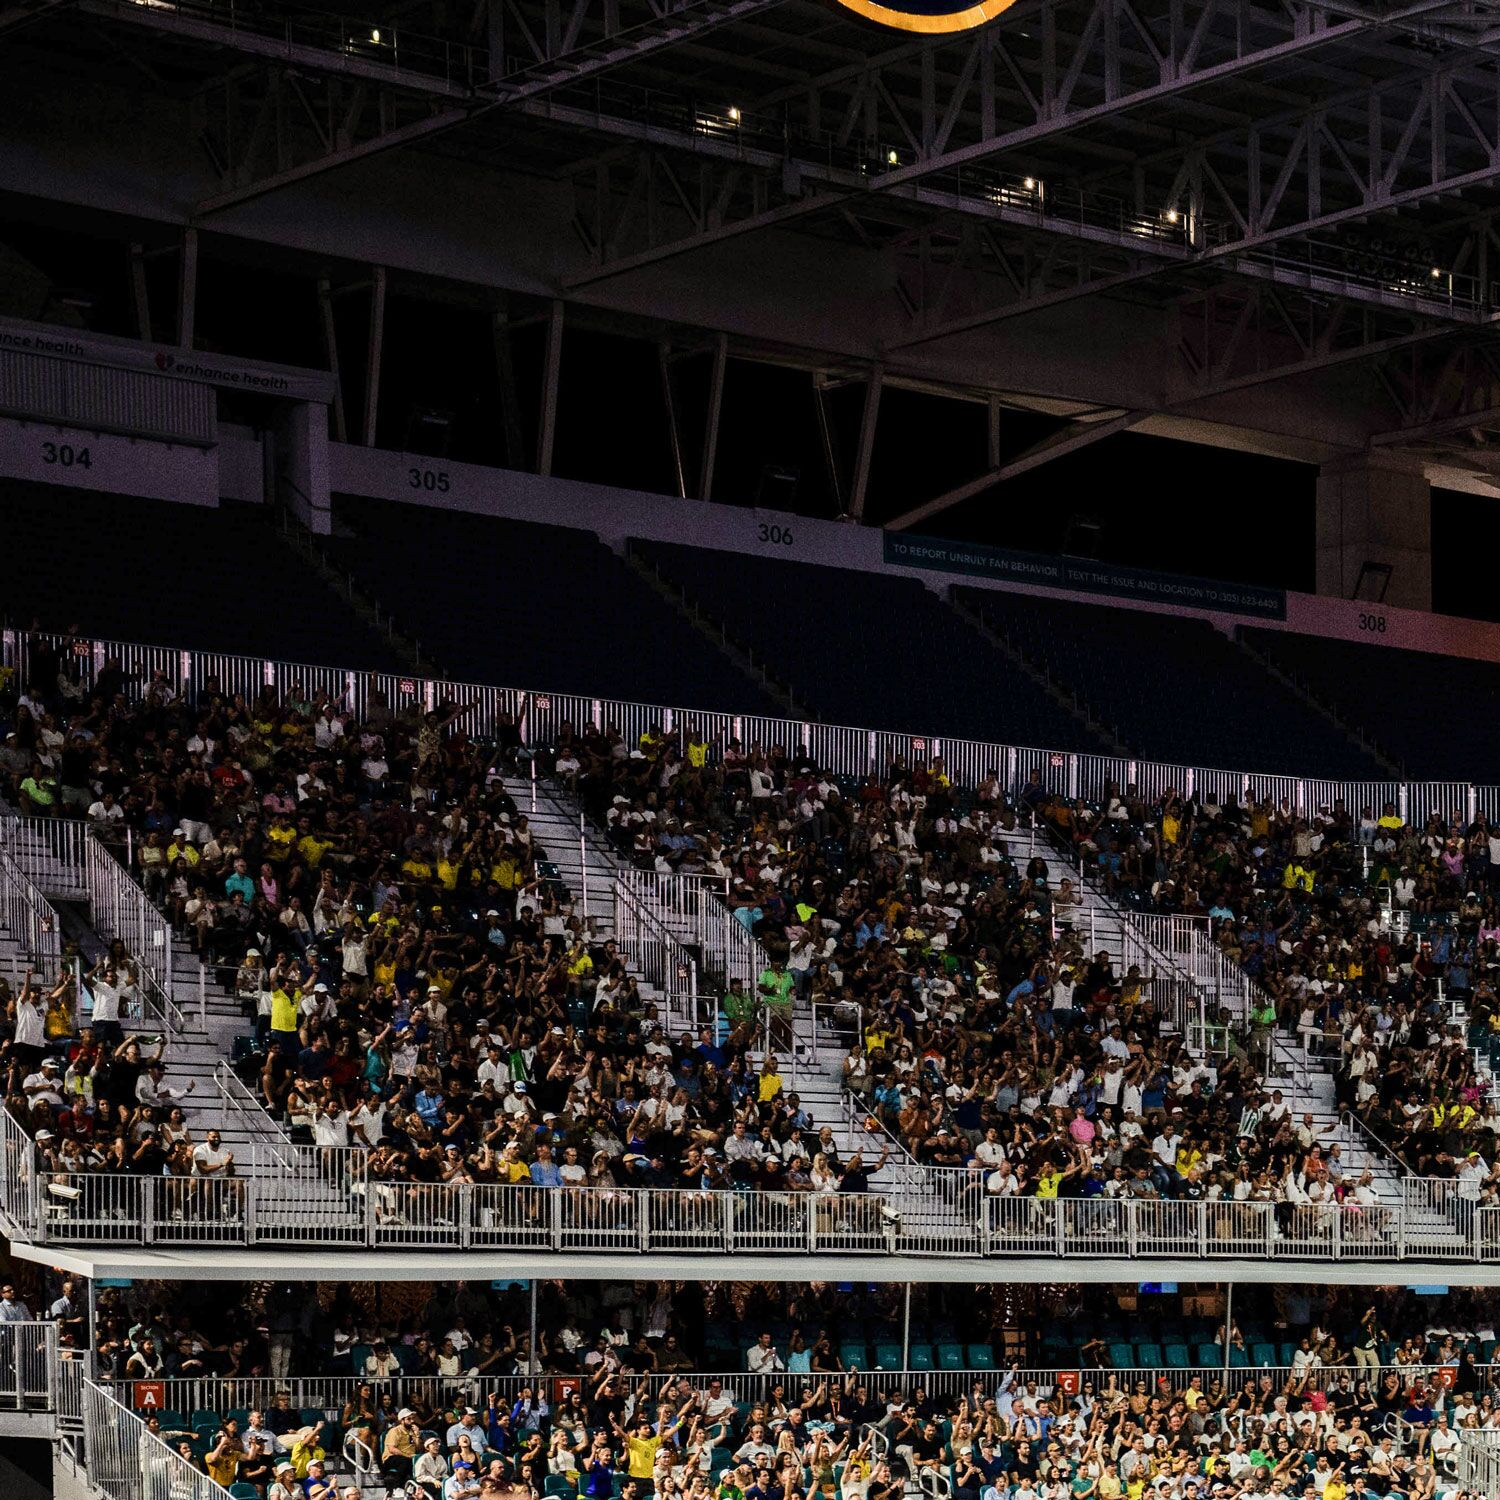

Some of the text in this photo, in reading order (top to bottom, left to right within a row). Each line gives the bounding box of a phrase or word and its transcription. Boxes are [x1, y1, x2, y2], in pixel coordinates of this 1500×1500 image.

[175, 361, 290, 391] enhance health
[42, 442, 93, 469] 304
[408, 468, 451, 493] 305
[757, 522, 794, 546] 306
[909, 546, 947, 561] REPORT
[950, 553, 987, 567] UNRULY
[989, 557, 1009, 570] FAN
[1011, 560, 1059, 577] BEHAVIOR
[1067, 569, 1089, 583] TEXT
[1093, 573, 1109, 585] THE
[1111, 575, 1136, 589] ISSUE
[1138, 579, 1157, 592] AND
[1159, 583, 1203, 599] LOCATION
[1358, 613, 1386, 633] 308
[74, 646, 90, 656] 102
[399, 684, 416, 694] 102
[535, 699, 551, 709] 103
[912, 741, 926, 750] 103
[1050, 758, 1064, 767] 104
[1063, 1379, 1073, 1391] C
[143, 1391, 157, 1406] A
